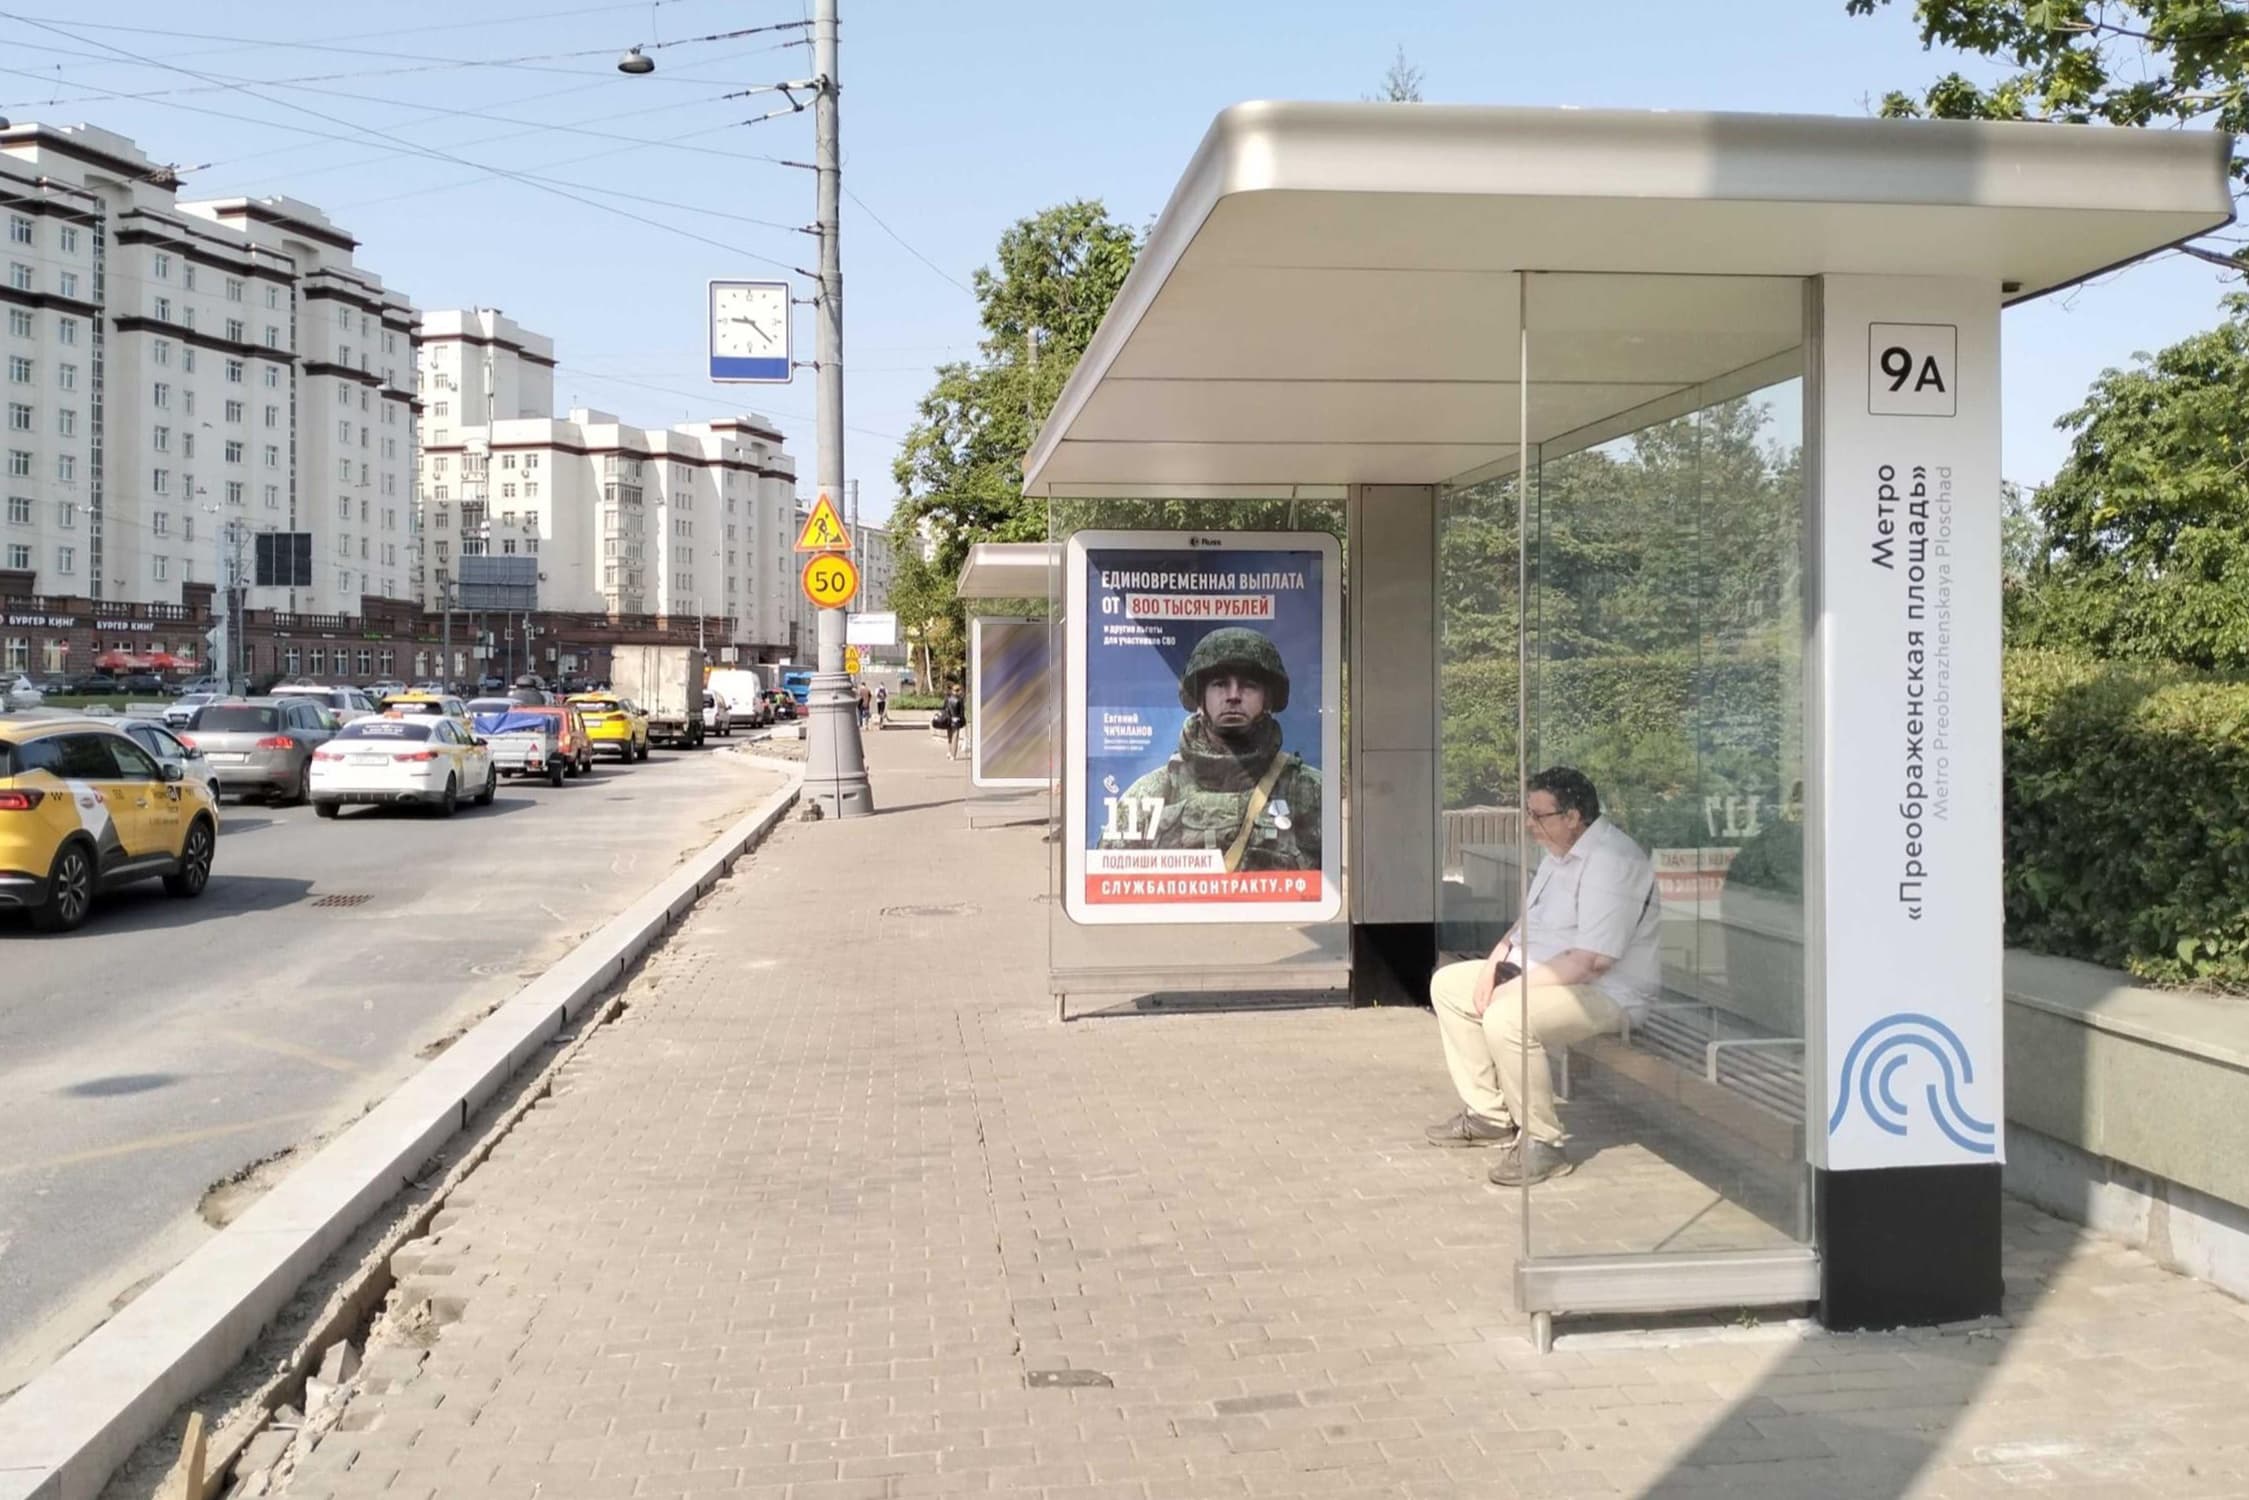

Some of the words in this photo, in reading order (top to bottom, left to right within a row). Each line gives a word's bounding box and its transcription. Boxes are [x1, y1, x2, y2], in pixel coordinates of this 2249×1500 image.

[1871, 464, 1900, 570] Метро
[1935, 466, 1952, 557] Ploschad
[1908, 465, 1930, 620] площадь»
[815, 571, 846, 593] 50
[1102, 570, 1236, 590] ЕДИНОВРЕМЕННАЯ
[1239, 572, 1304, 590] ВЫПЛАТА
[9, 615, 46, 626] БУРГЕР
[49, 616, 75, 627] КИНГ
[1102, 596, 1120, 614] ОТ
[1132, 598, 1160, 615] 800
[1163, 599, 1211, 616] ТЫСЯЧ
[1215, 595, 1269, 616] РУБЛЕЙ
[96, 621, 129, 630] БУРГЕР
[131, 622, 154, 631] КИНГ
[1933, 564, 1954, 750] Preobrazhenskaya
[1899, 631, 1929, 920] «Преображенская
[1933, 756, 1949, 821] Metro
[1102, 797, 1165, 840] 117
[1102, 855, 1158, 869] ПОДПИШИ
[1160, 855, 1213, 869] КОНТРАКТ
[1101, 877, 1307, 897] СЛУЖБАПОКОНТРАКТУ.РФ
